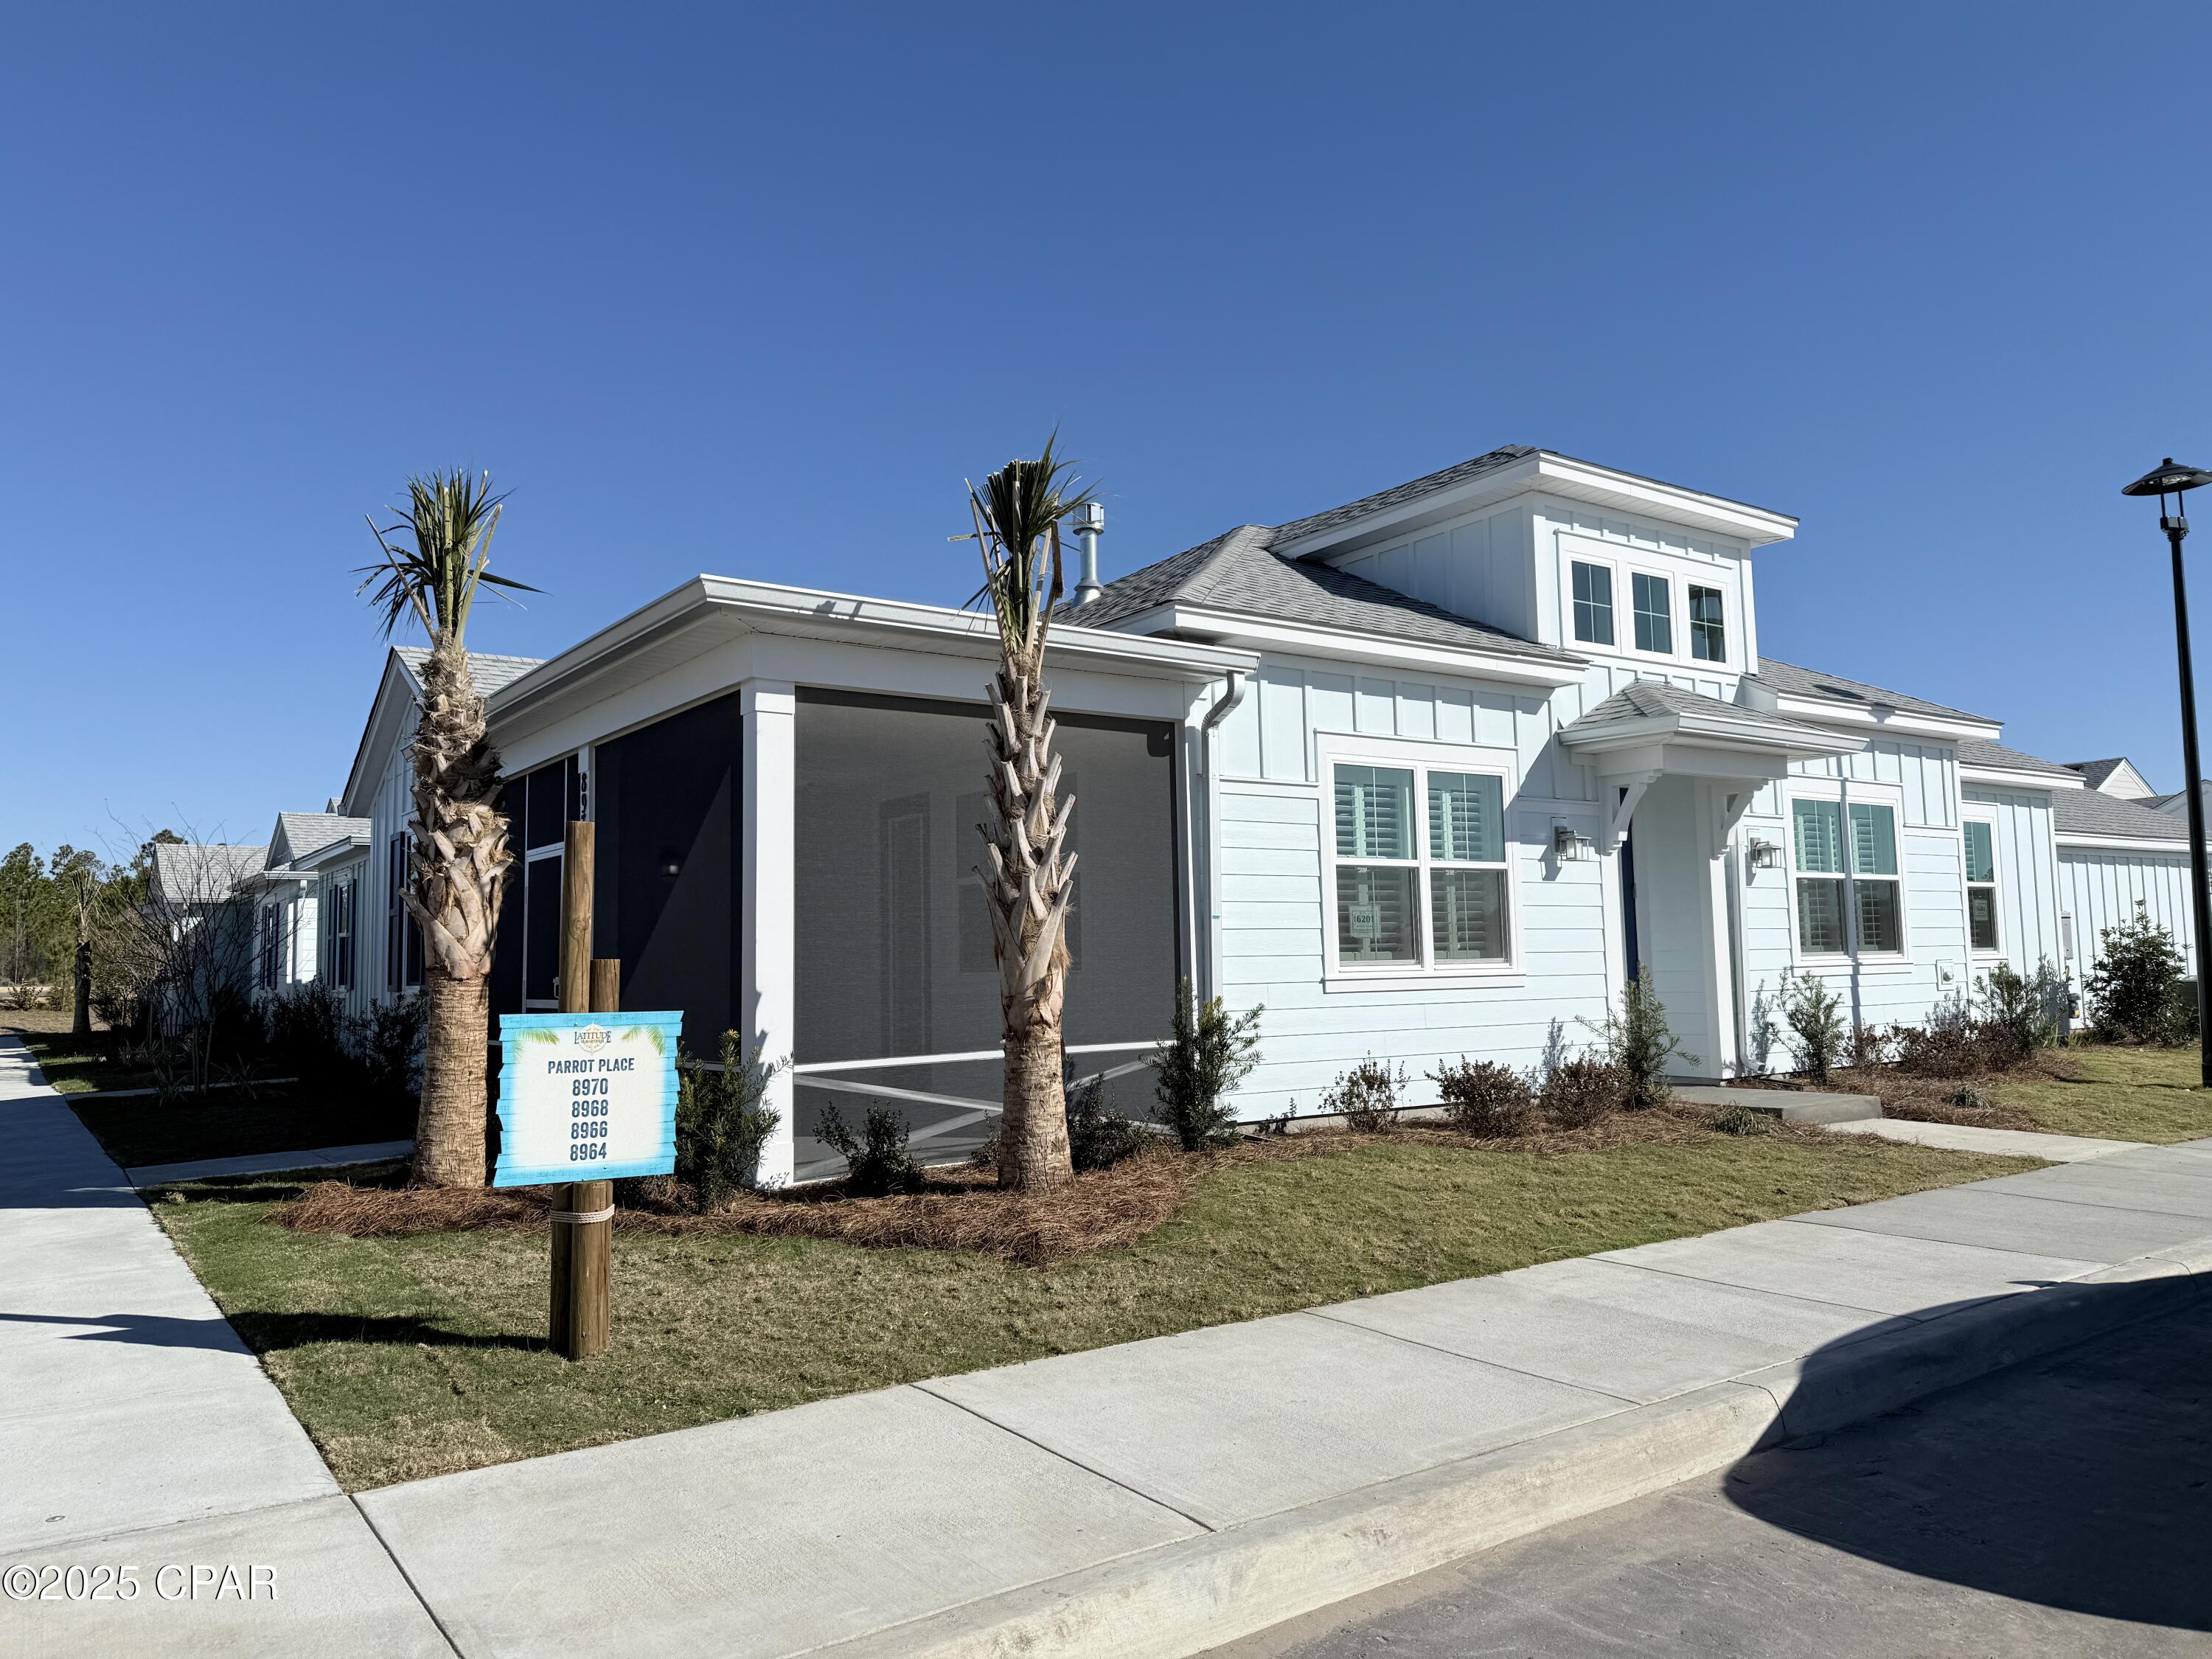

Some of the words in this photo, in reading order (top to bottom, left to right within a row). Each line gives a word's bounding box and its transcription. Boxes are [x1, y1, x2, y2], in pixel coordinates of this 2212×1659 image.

[574, 1031, 612, 1044] LATITUDE
[548, 1059, 595, 1074] PARROT
[599, 1058, 635, 1072] PLACE
[572, 1078, 608, 1096] 8970
[571, 1099, 608, 1118] 8968
[571, 1121, 608, 1139] 8966
[570, 1142, 607, 1161] 8964
